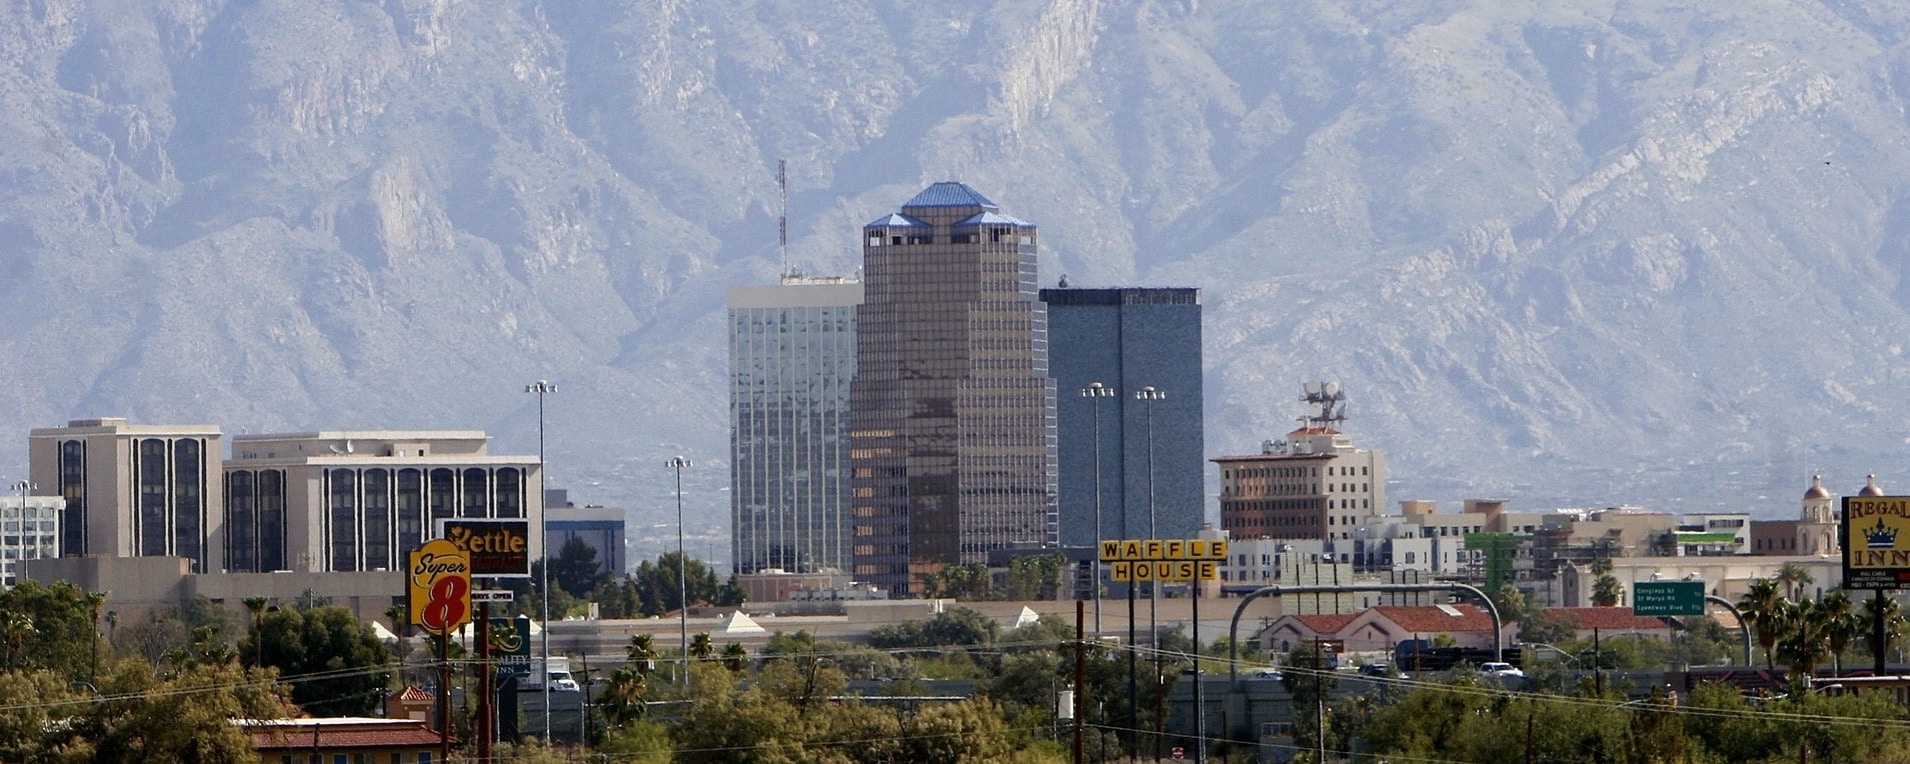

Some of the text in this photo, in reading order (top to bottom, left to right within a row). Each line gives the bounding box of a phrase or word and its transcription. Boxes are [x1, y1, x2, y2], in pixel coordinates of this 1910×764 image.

[1850, 501, 1910, 519] REGAL
[450, 526, 525, 552] Kettle
[1104, 542, 1223, 557] WAFFLE
[1854, 550, 1910, 566] INN
[414, 553, 467, 584] Super
[1115, 563, 1212, 578] HOUSE
[421, 575, 467, 630] 8
[498, 655, 528, 666] ALITY
